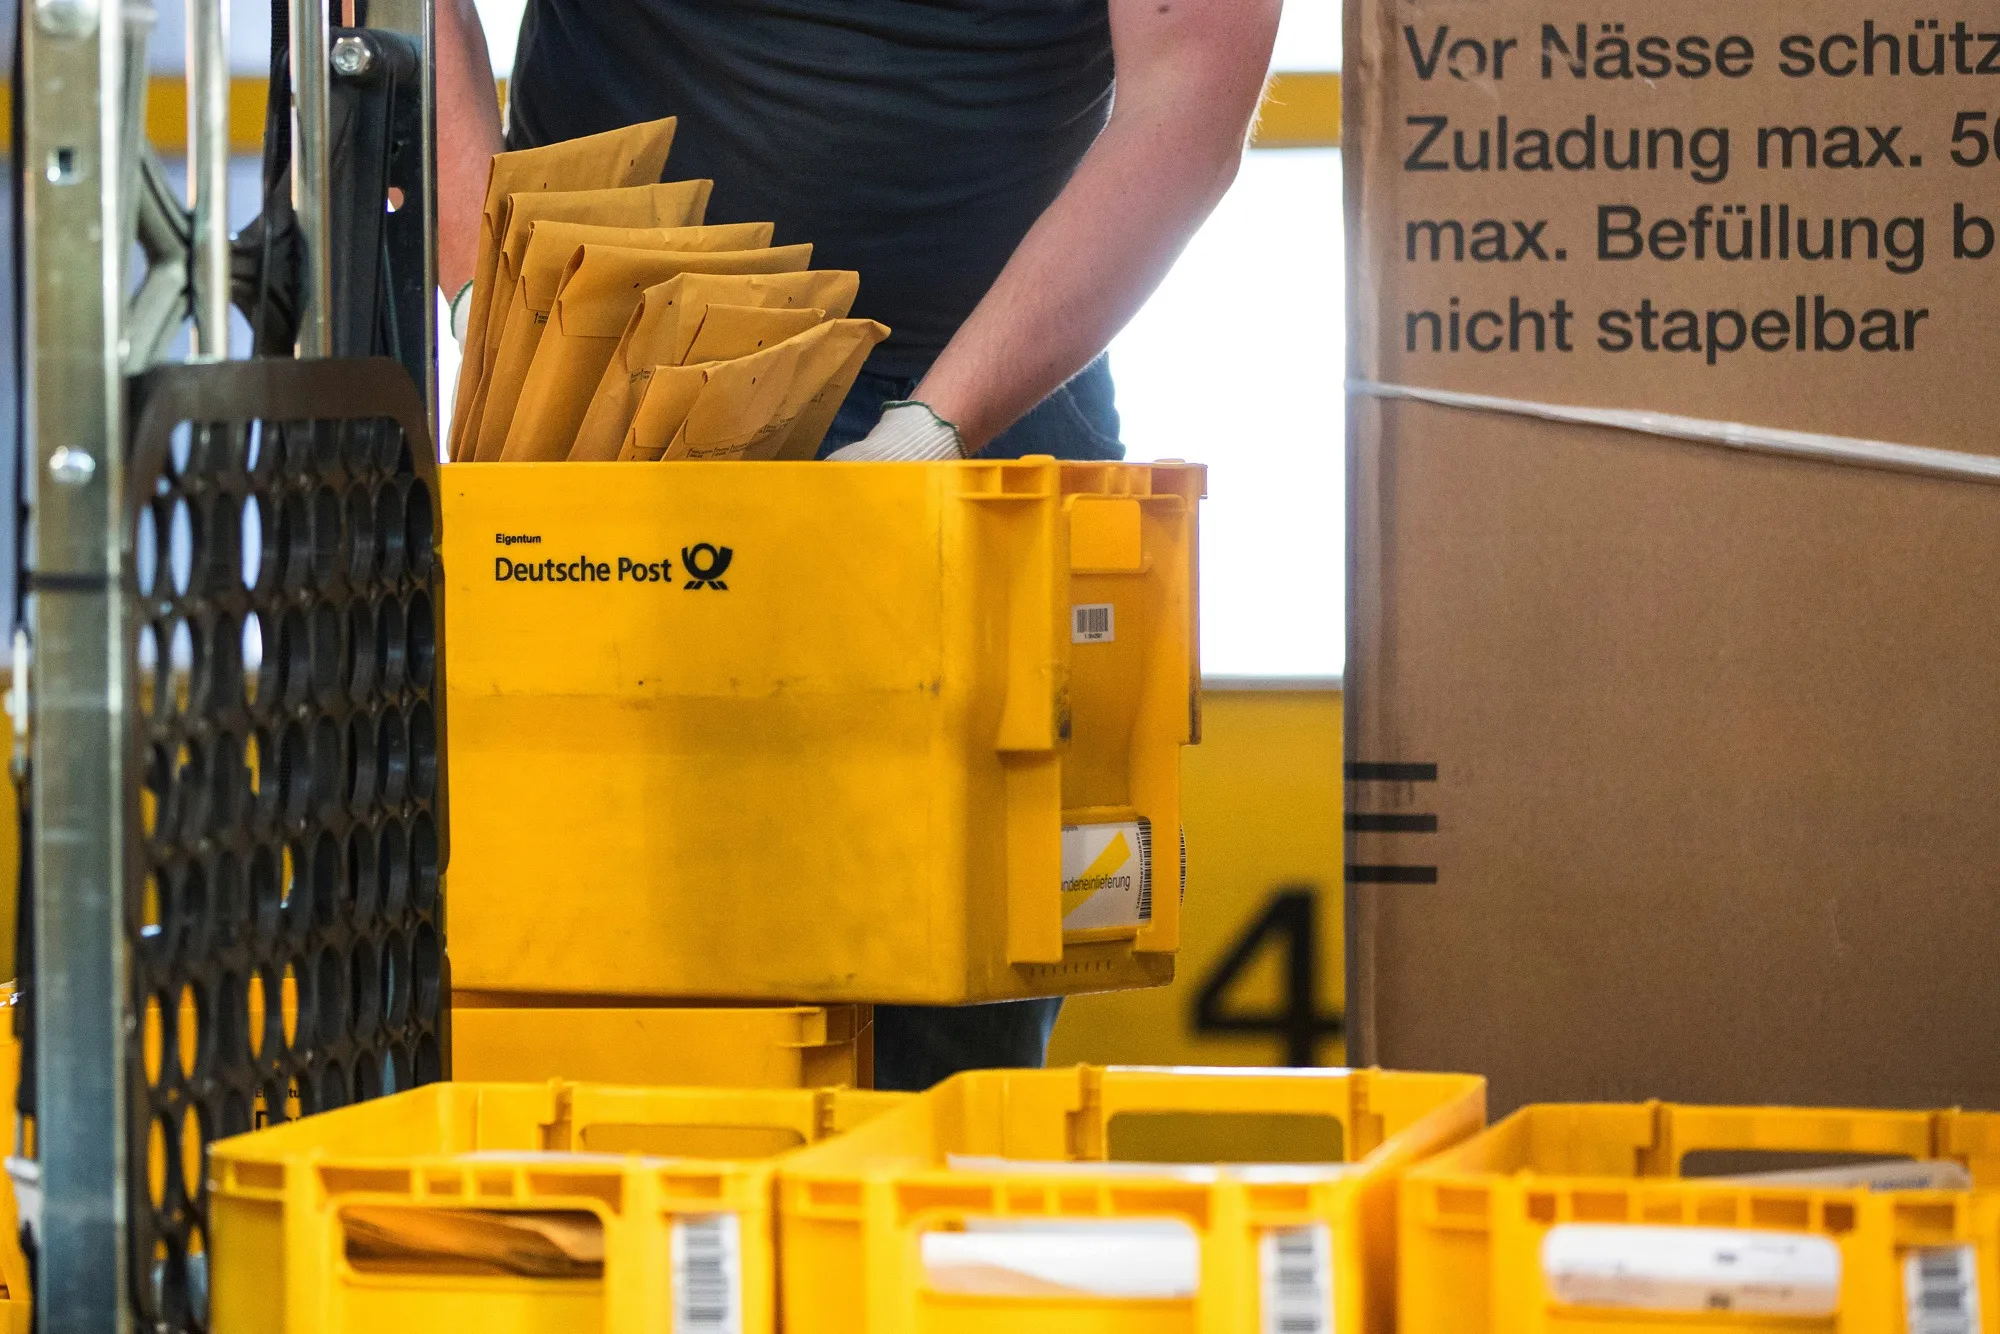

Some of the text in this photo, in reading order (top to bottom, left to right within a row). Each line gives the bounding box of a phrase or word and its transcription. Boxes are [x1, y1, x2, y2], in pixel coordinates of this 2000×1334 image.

[1404, 19, 2000, 81] Vor Nässe schütz
[1404, 111, 2000, 184] Zuladung max. 5
[1406, 219, 1568, 262] max.
[1597, 203, 1925, 275] Befüllung
[1406, 294, 1930, 365] nicht stapelbar
[495, 533, 542, 546] Eigentum
[495, 555, 672, 583] Deutsche Post
[1194, 886, 1346, 1067] 4
